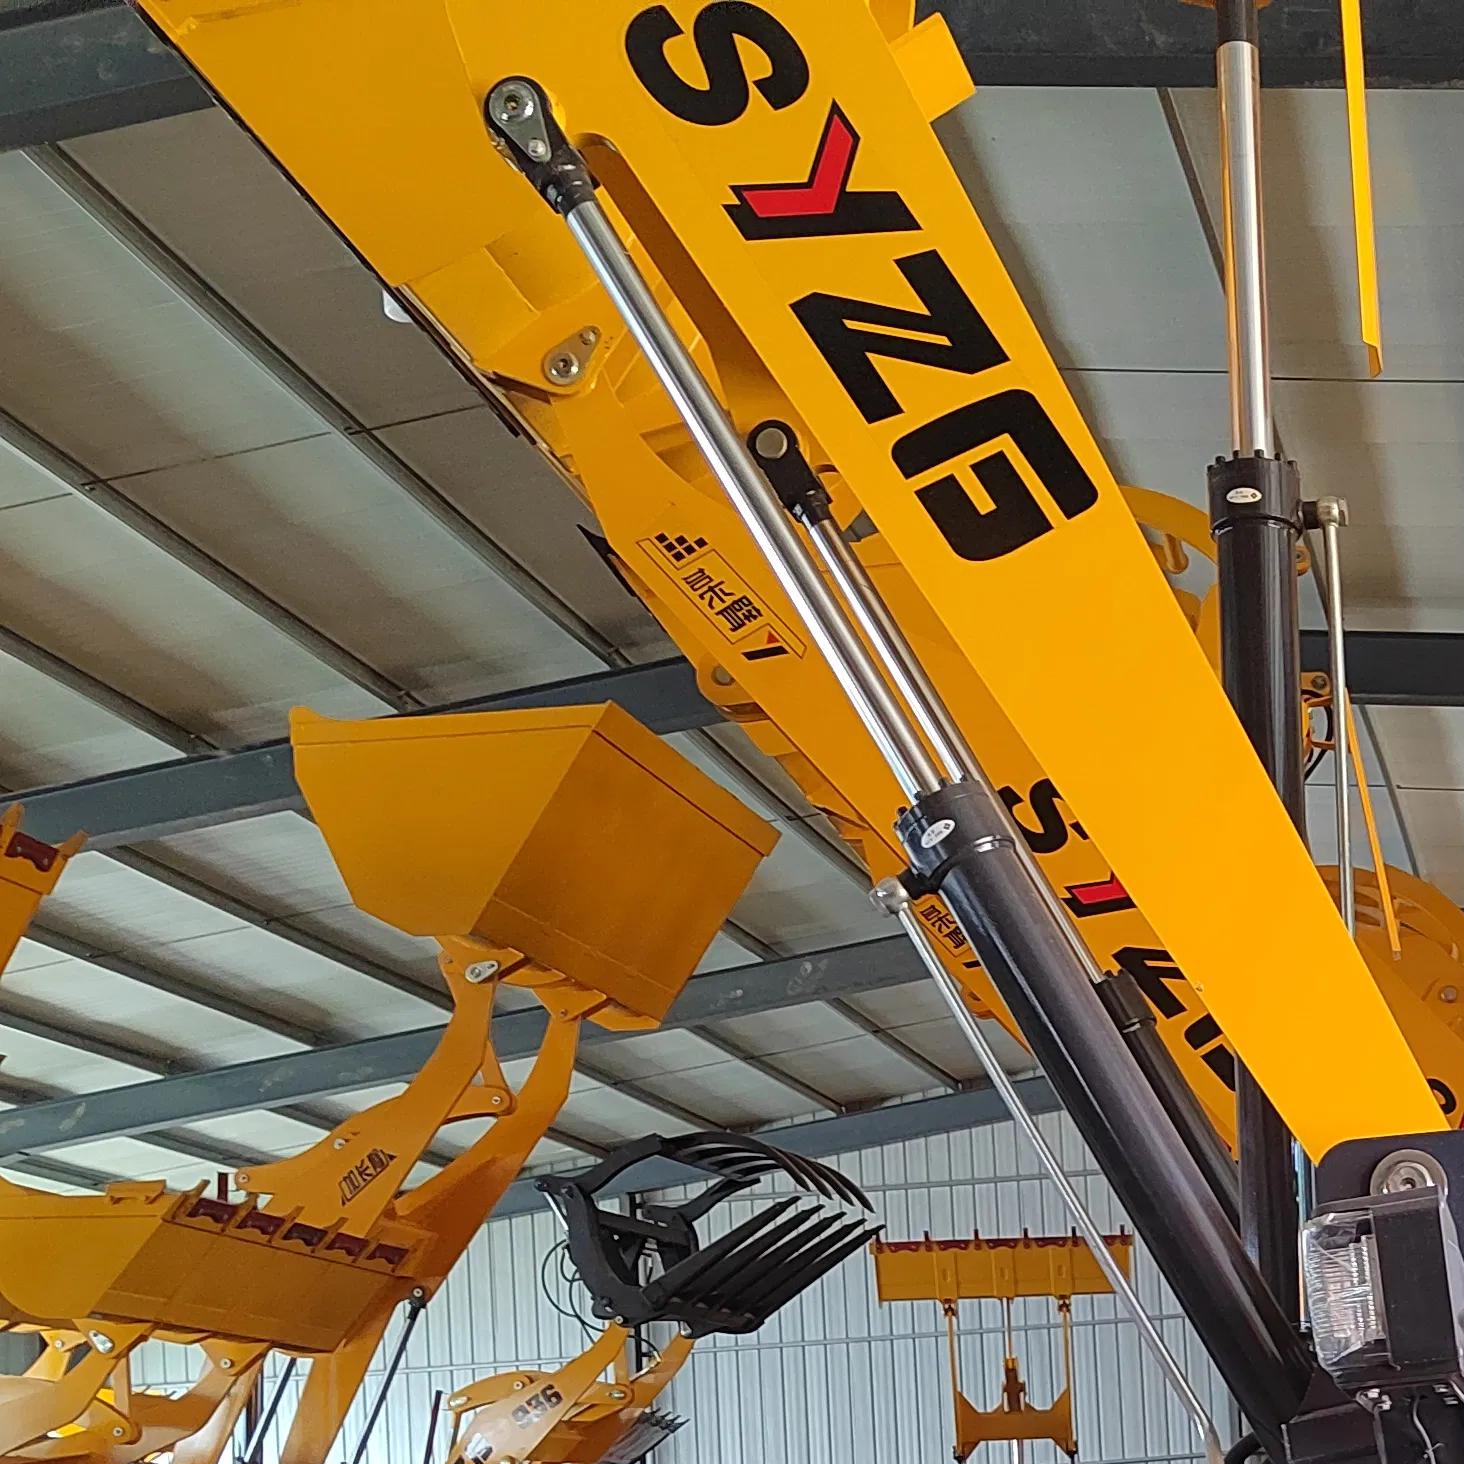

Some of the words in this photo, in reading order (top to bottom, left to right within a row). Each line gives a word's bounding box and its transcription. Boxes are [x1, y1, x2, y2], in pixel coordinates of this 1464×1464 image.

[625, 1, 1098, 561] SYZG
[683, 566, 764, 635] 加长臂
[512, 1383, 564, 1430] 936
